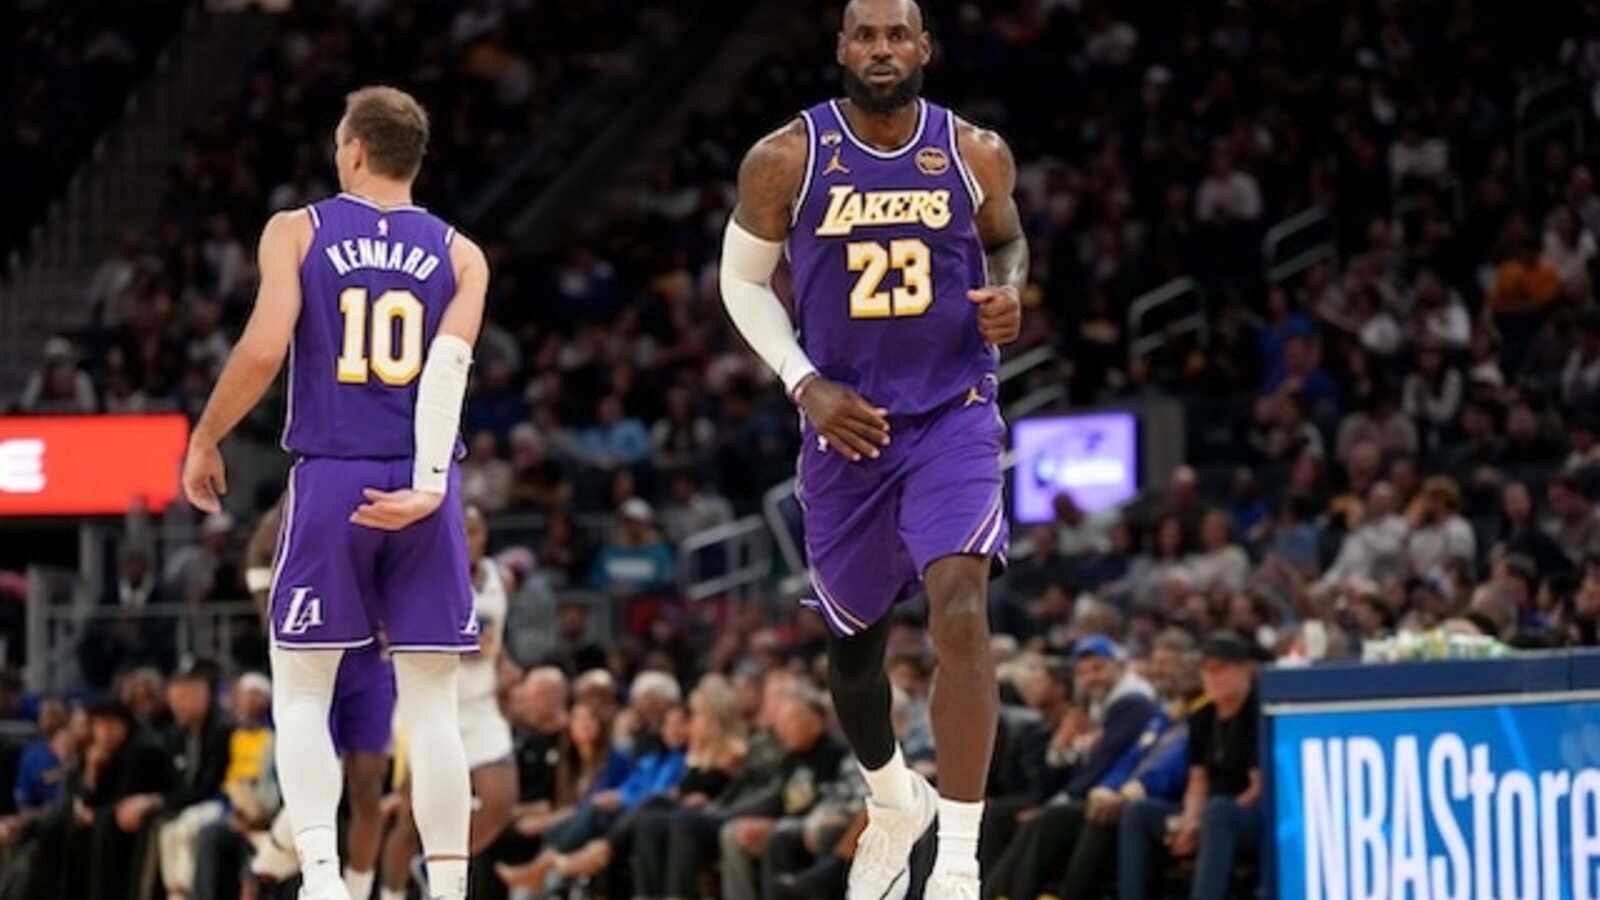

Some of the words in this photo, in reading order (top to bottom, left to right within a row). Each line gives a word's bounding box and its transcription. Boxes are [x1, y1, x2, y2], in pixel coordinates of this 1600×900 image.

[815, 185, 952, 236] LAKERS
[325, 237, 440, 281] KENNARD
[847, 238, 933, 318] 23
[337, 287, 424, 386] 10
[1301, 732, 1600, 900] NBAStore
